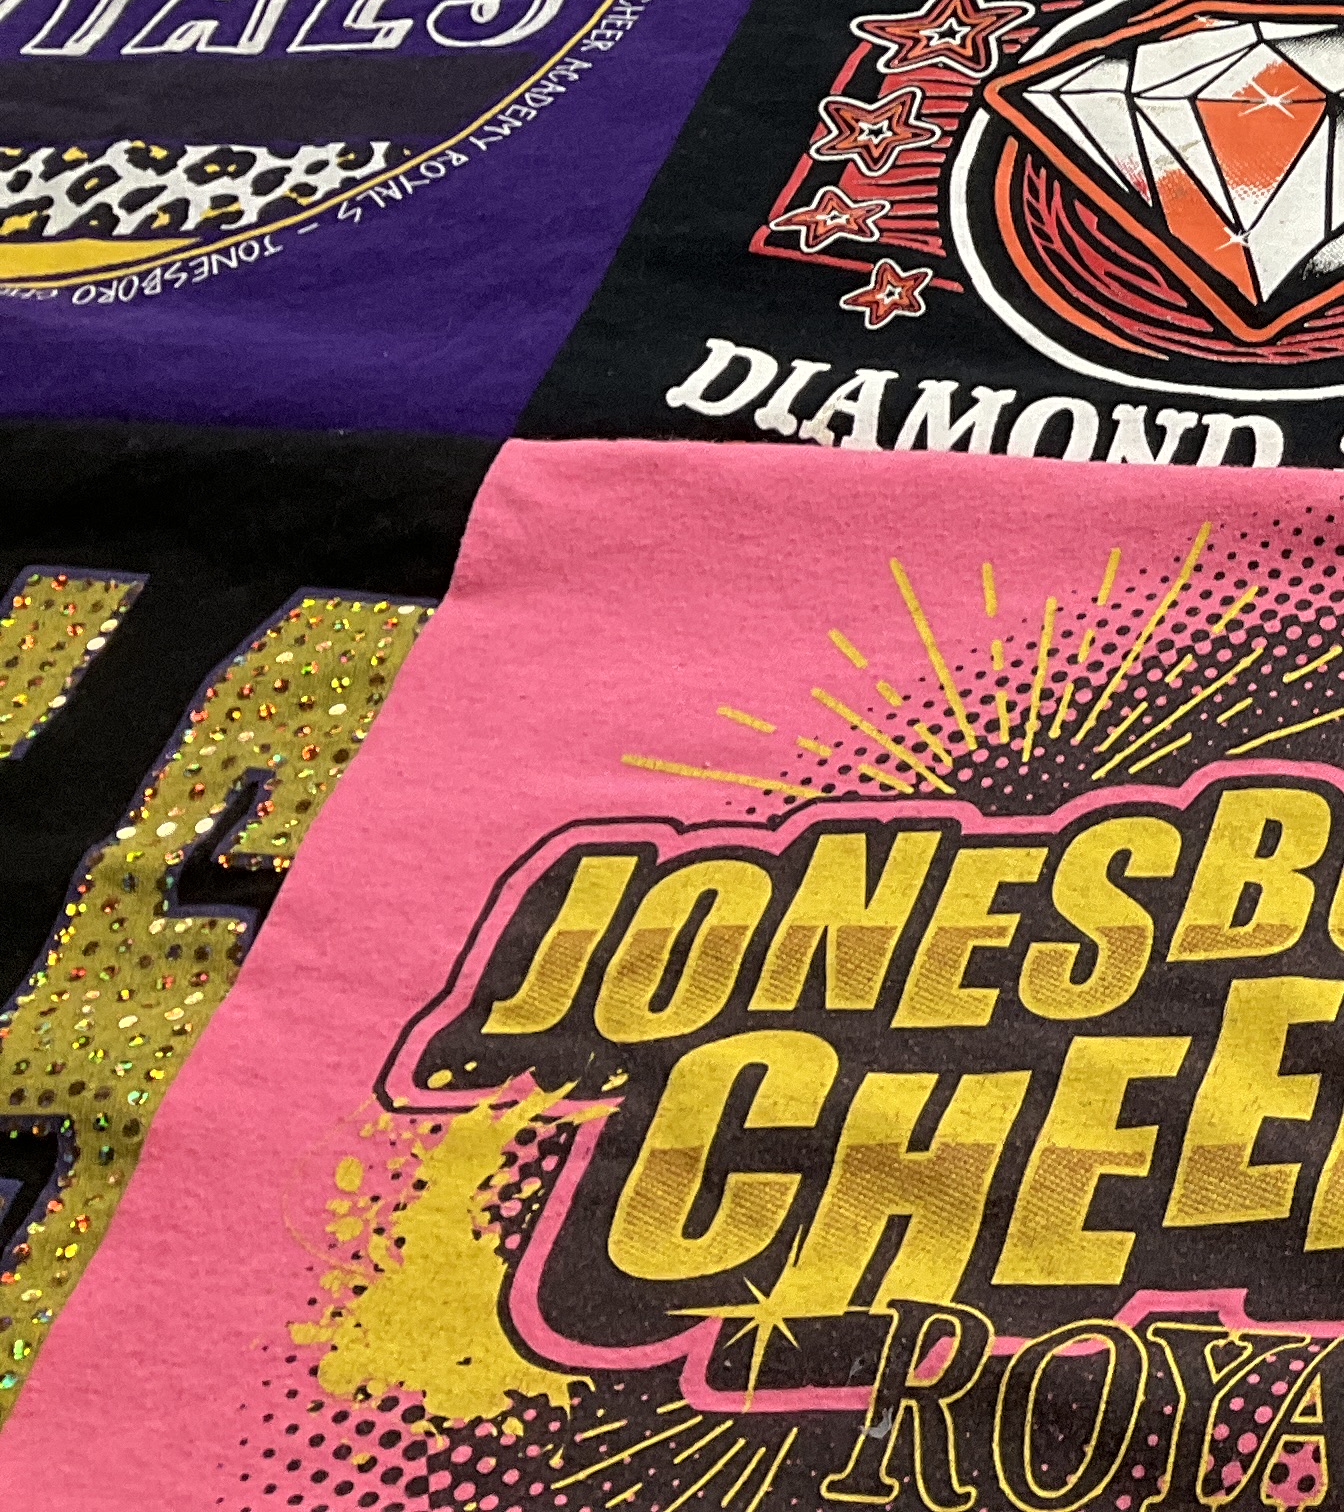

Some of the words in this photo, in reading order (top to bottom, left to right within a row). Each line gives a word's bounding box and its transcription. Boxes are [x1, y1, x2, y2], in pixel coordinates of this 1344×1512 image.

[470, 56, 593, 154] ACADEMY
[336, 149, 470, 224] ROYALS
[71, 235, 284, 306] JONESBORO
[663, 336, 1284, 470] DIAMOND
